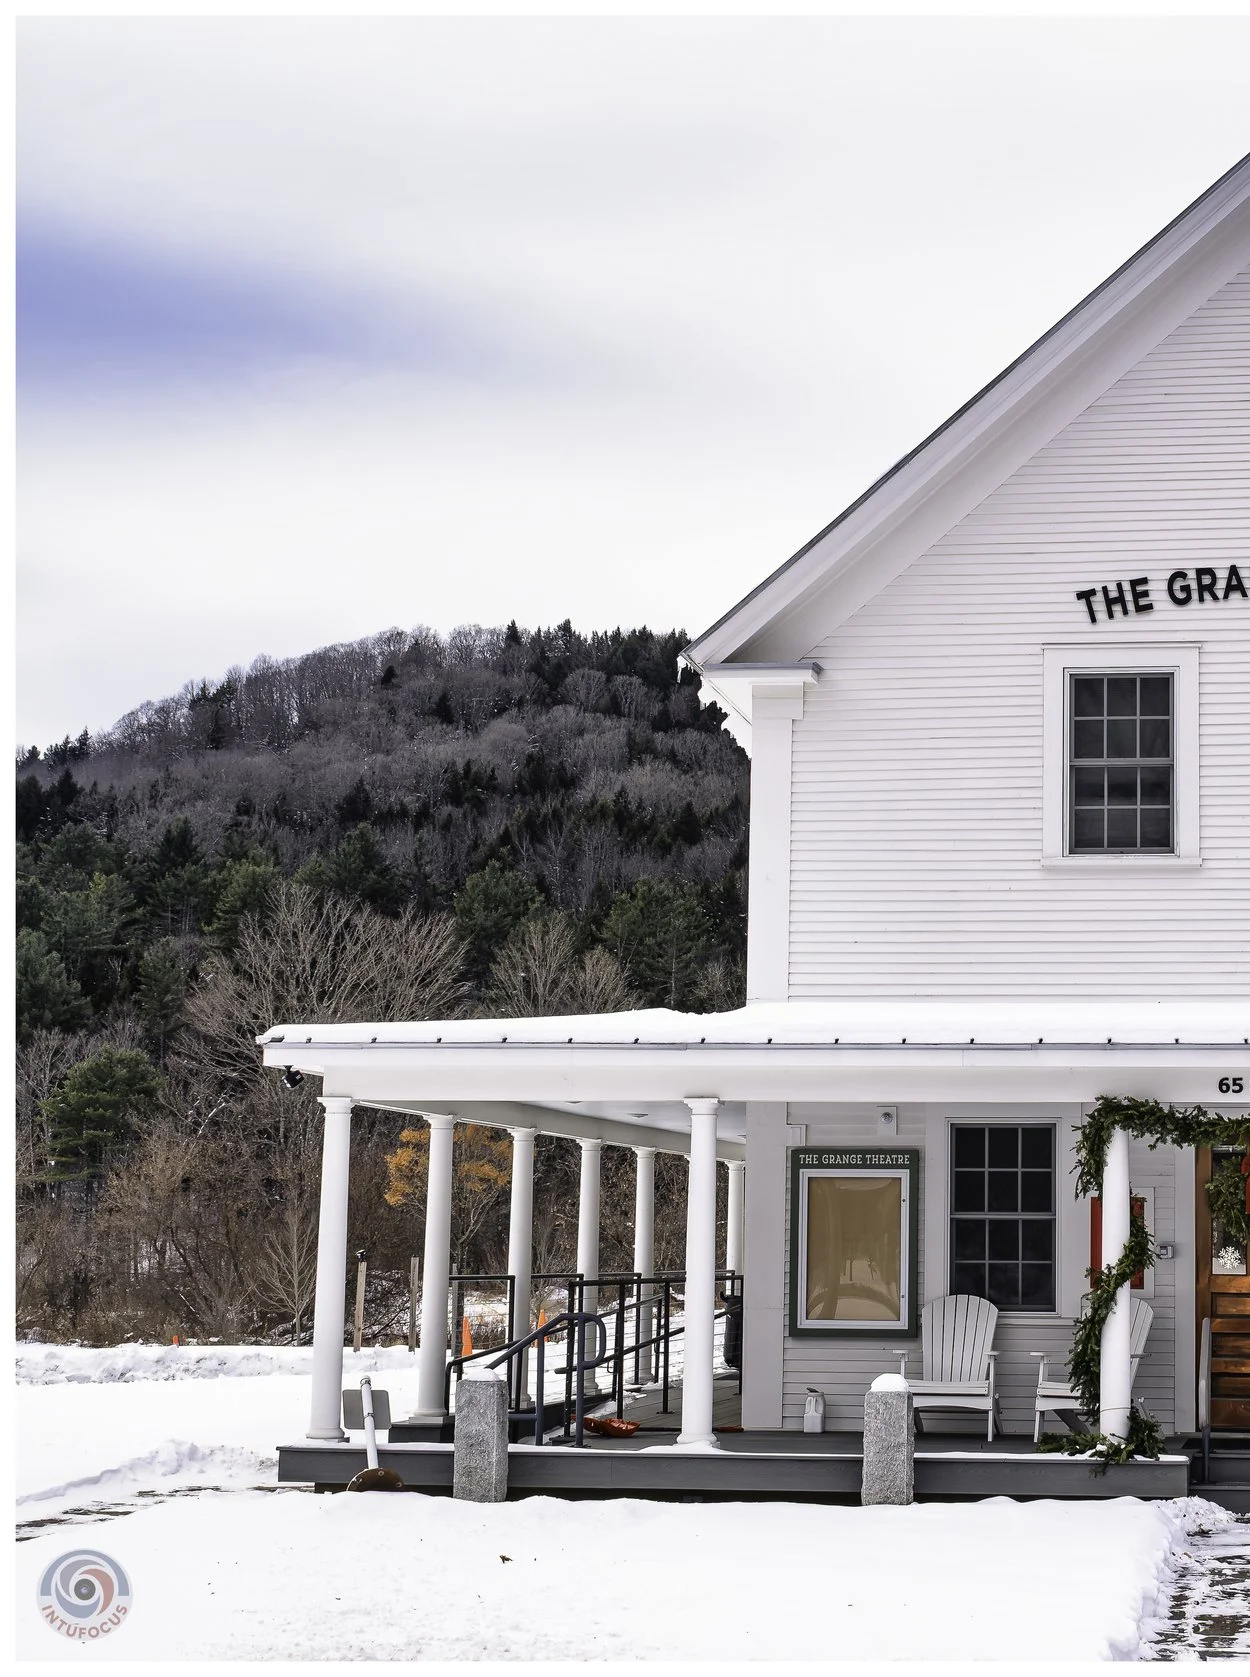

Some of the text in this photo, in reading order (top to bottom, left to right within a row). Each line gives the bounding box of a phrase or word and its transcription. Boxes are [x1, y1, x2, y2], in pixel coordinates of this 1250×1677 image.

[1075, 576, 1154, 624] THE
[1218, 1077, 1244, 1094] 65
[799, 1154, 910, 1165] THE GRANGE THEATRE
